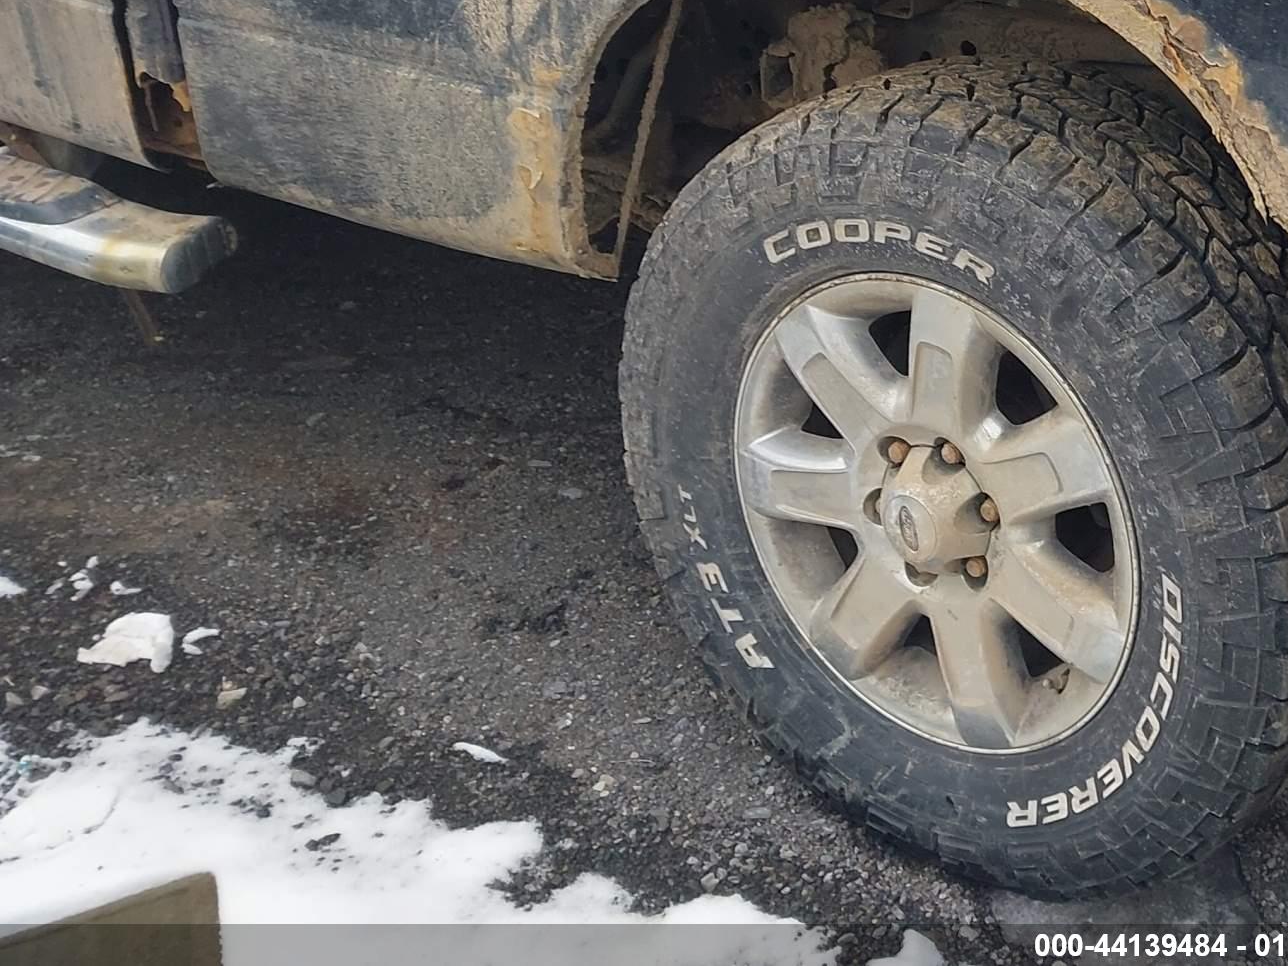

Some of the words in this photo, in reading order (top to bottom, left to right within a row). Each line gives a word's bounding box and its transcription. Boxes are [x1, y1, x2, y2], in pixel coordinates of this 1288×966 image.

[762, 217, 997, 286] COOPER
[677, 483, 709, 551] XLT
[1005, 572, 1184, 828] DISCOVERER
